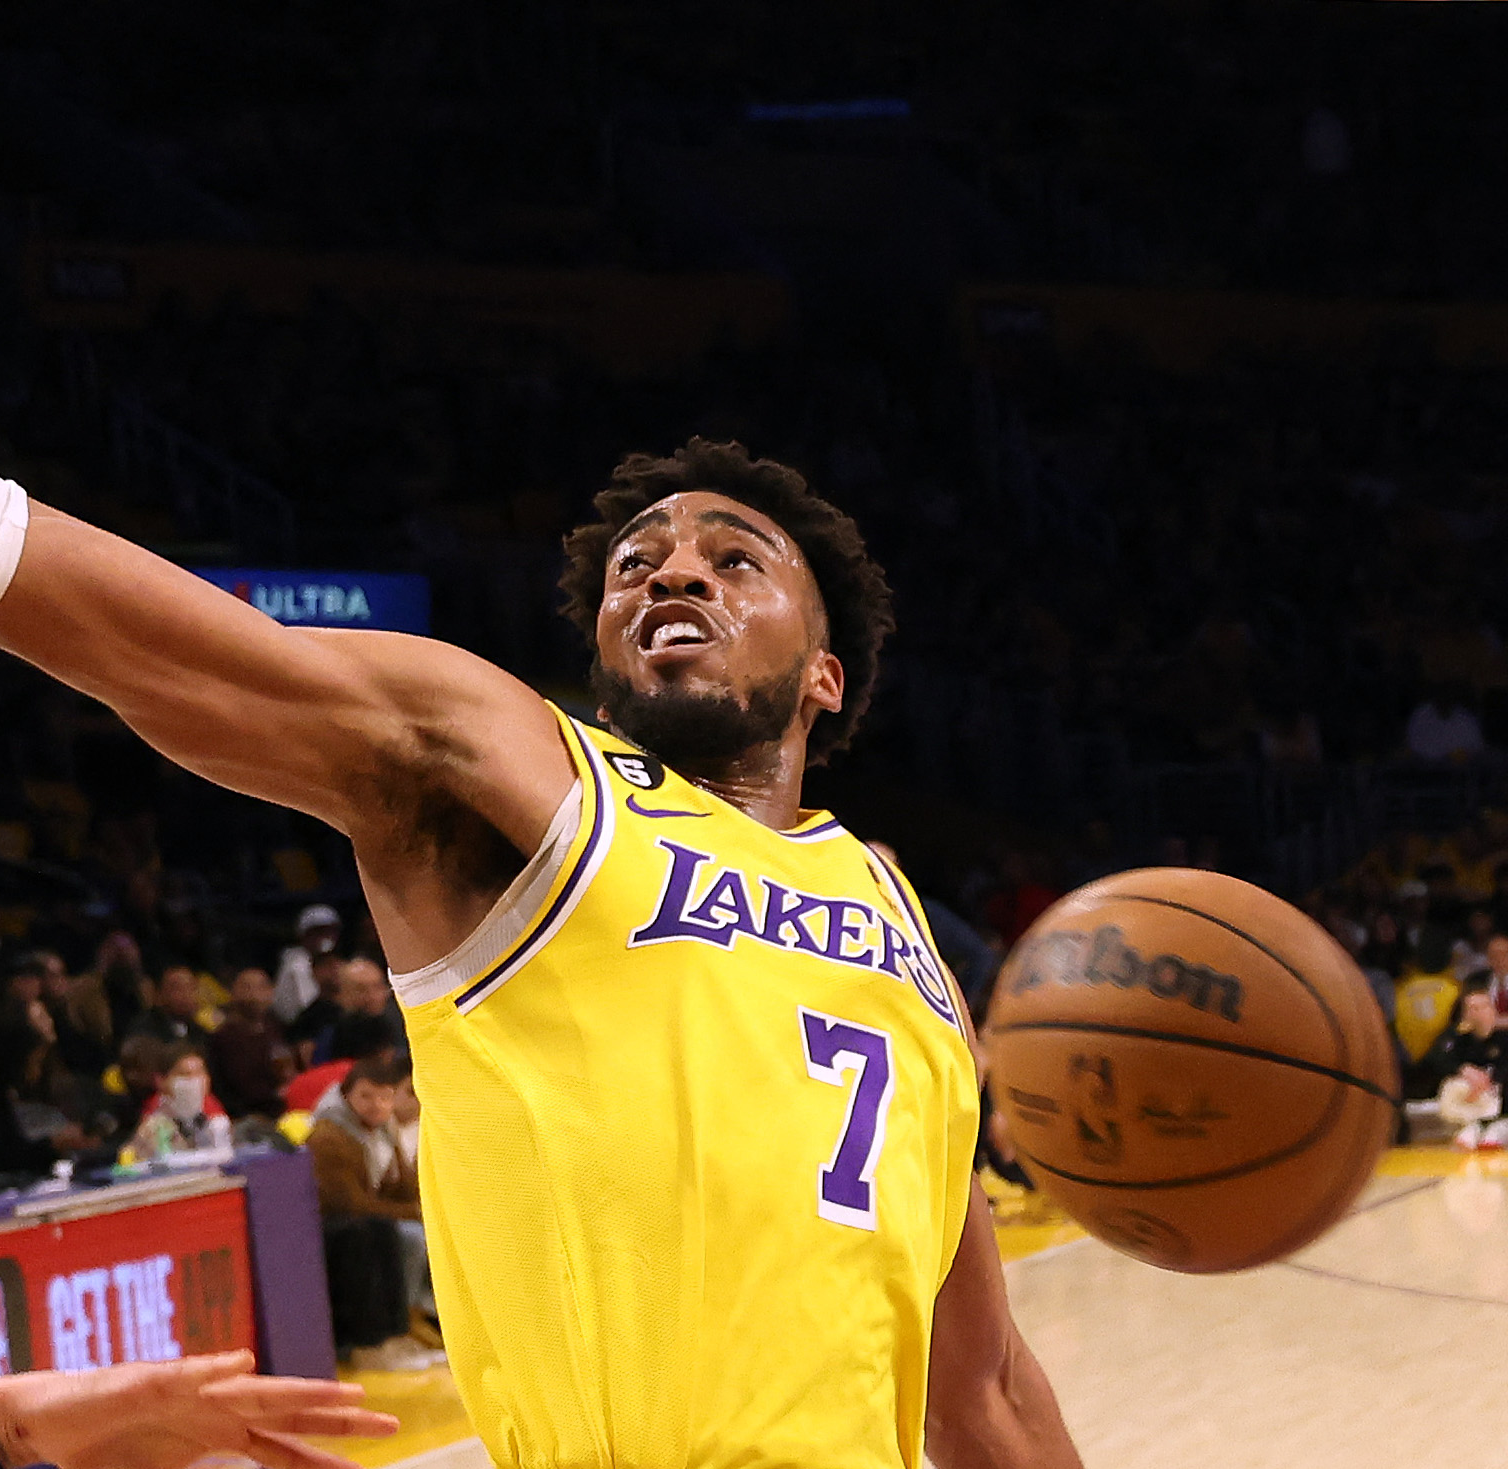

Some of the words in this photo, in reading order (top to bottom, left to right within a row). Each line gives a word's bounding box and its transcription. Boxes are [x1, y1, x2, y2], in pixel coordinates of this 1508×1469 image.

[252, 583, 371, 621] ULTRA
[612, 756, 653, 788] 6
[626, 835, 960, 1032] LAKERS
[797, 1004, 894, 1231] 7
[48, 1268, 114, 1374] GET
[114, 1253, 182, 1367] THE
